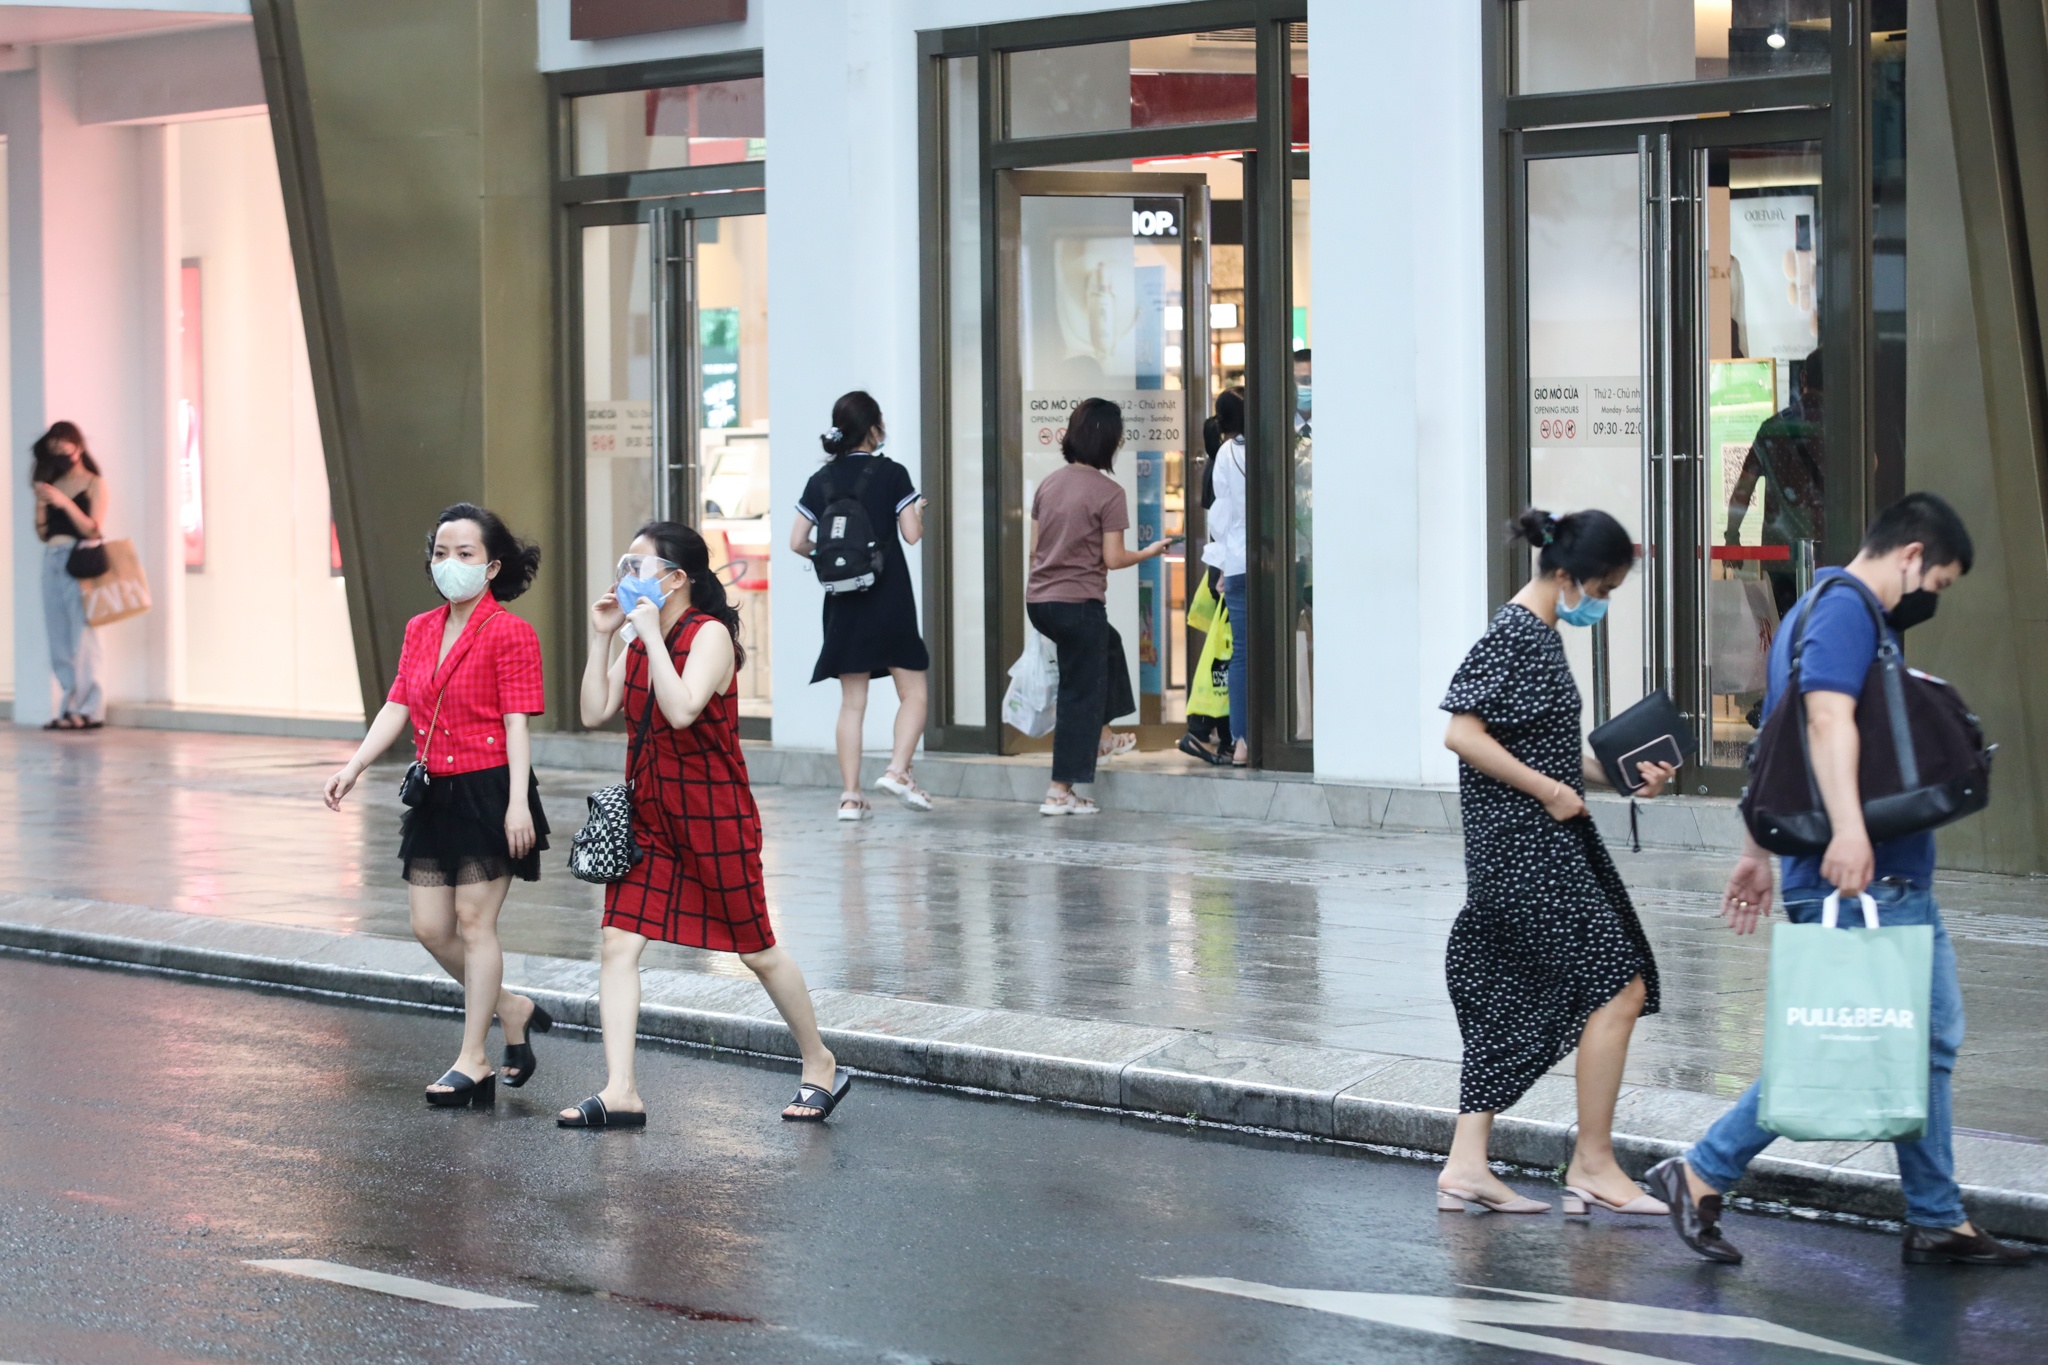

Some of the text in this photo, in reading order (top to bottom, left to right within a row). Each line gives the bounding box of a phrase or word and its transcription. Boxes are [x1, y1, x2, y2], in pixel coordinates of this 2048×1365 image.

[1608, 388, 1612, 399] 2
[1631, 388, 1641, 399] nh
[1127, 400, 1132, 409] 2
[1534, 405, 1579, 415] OPENING HOURS
[1601, 405, 1622, 416] Monday
[1031, 415, 1063, 424] OPENING
[1150, 414, 1174, 424] Sunday
[1593, 421, 1618, 435] 09:30
[1148, 428, 1180, 441] 22:00
[1786, 1006, 1915, 1029] PULL&BEAR
